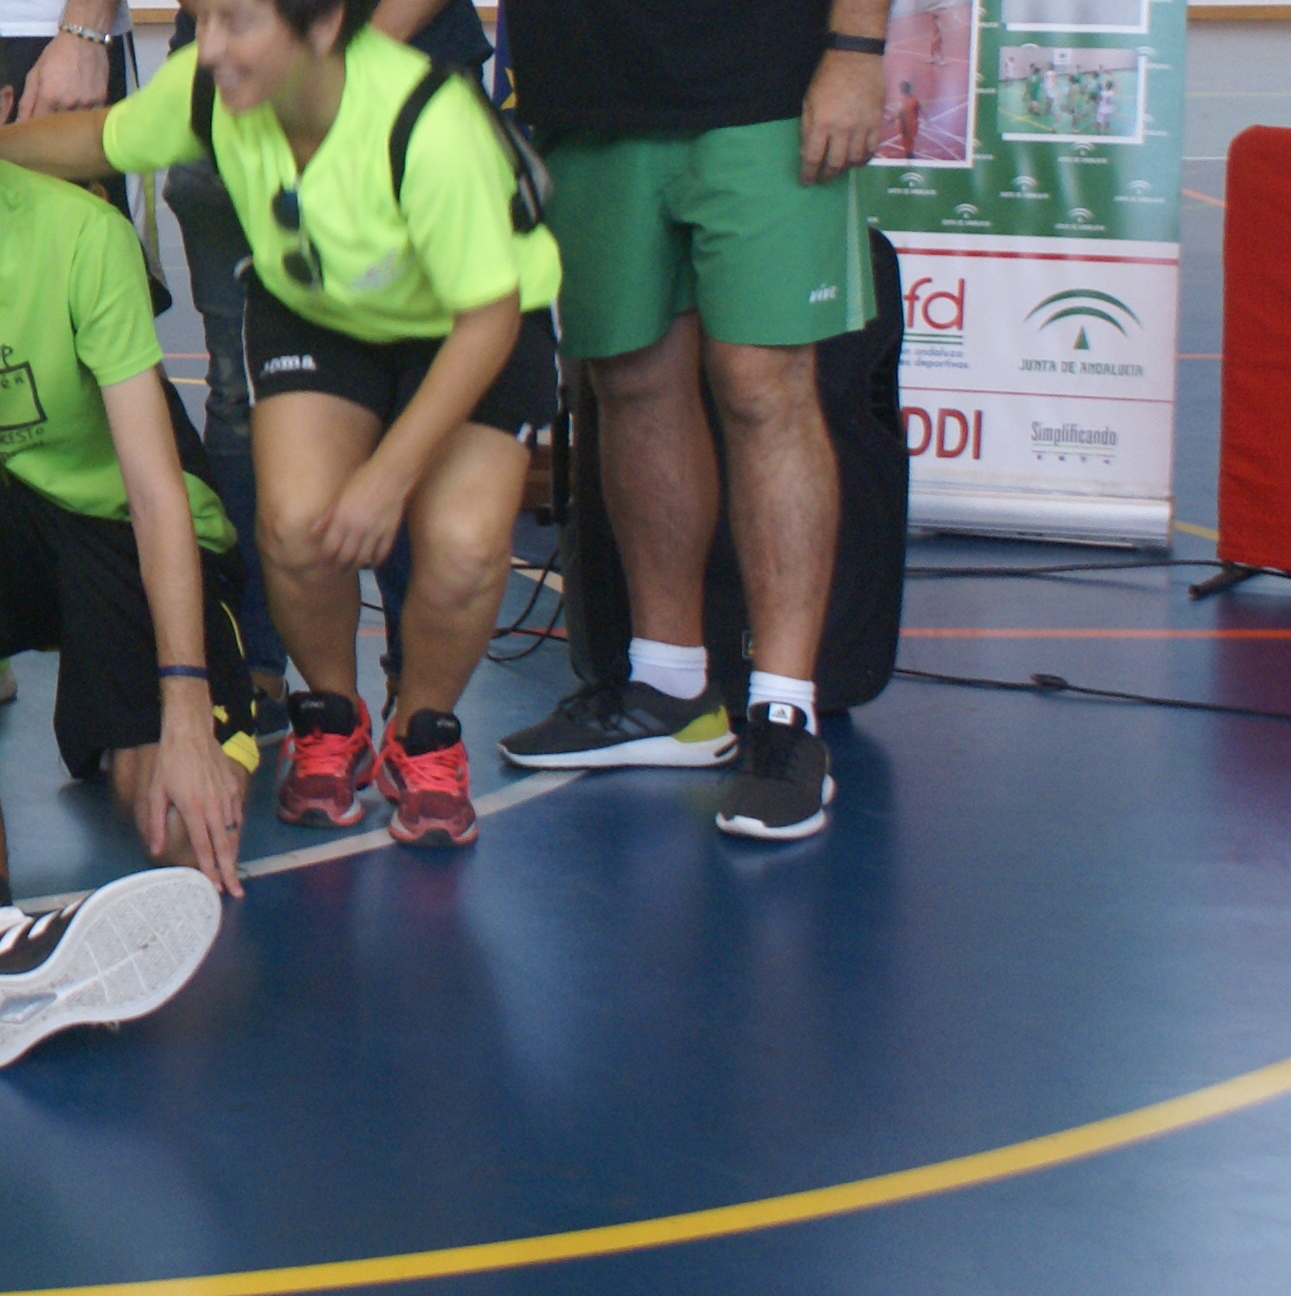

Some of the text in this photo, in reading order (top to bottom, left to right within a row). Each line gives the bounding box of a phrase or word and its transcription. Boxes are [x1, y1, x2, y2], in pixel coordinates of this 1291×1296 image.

[1019, 358, 1057, 373] JUNTA
[1060, 360, 1076, 374] DE
[901, 406, 983, 460] DDI
[1030, 420, 1118, 446] Simplificando
